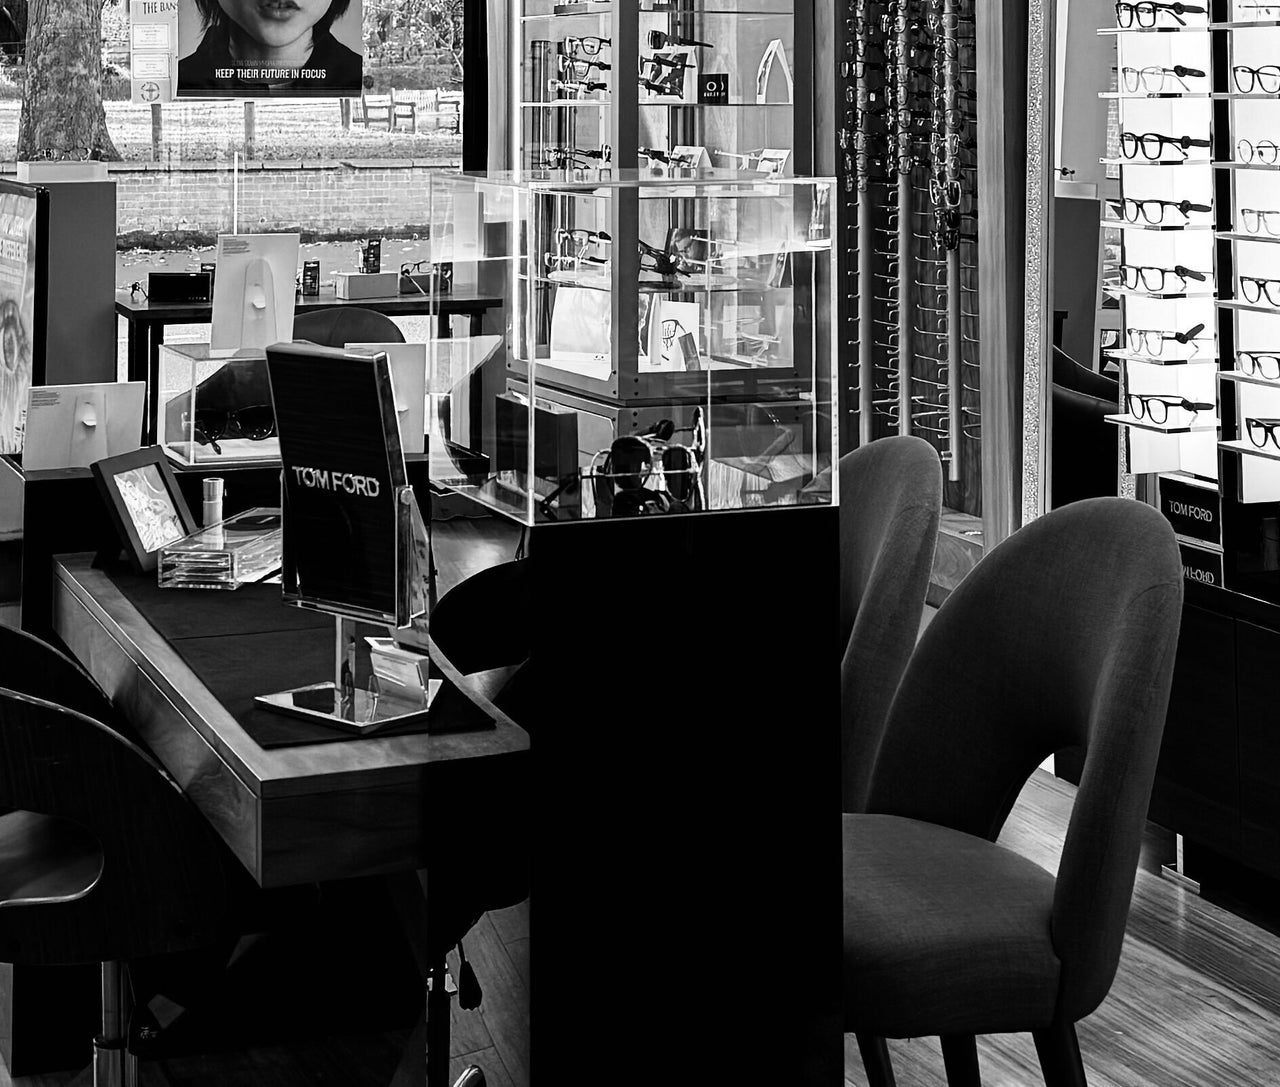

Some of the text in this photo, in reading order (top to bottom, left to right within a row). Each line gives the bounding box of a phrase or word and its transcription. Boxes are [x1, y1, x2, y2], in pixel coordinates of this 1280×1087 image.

[143, 1, 158, 15] THE
[215, 68, 327, 79] KEEP THEIR FUTURE IN FOCUS
[291, 466, 380, 497] TOM FORD
[1168, 499, 1213, 522] TOM FORD
